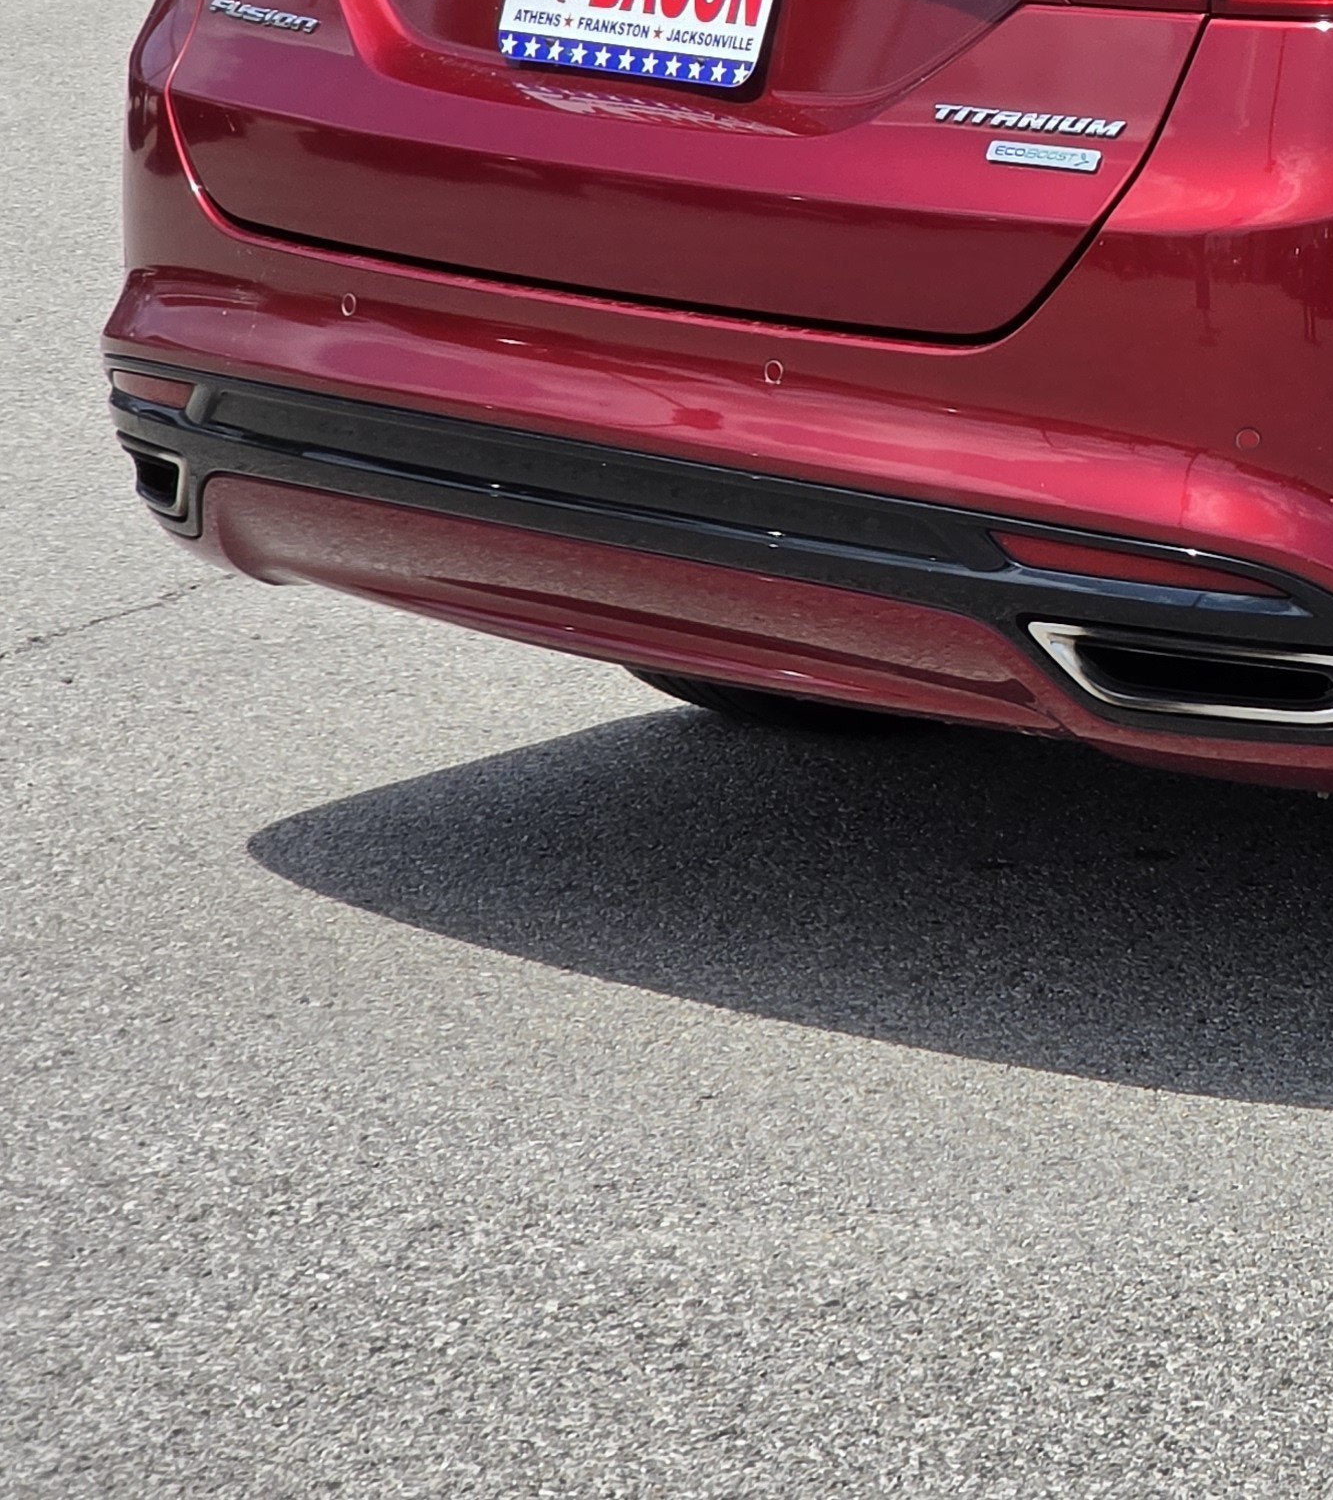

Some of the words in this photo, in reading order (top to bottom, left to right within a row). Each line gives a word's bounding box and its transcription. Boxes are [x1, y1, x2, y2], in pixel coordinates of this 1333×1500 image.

[513, 9, 563, 28] ATHENS
[577, 17, 650, 39] FRANKSTON
[666, 28, 755, 52] JACKSONVILLE
[934, 103, 1128, 139] TITANIUM
[994, 145, 1078, 162] ECOBOOST
